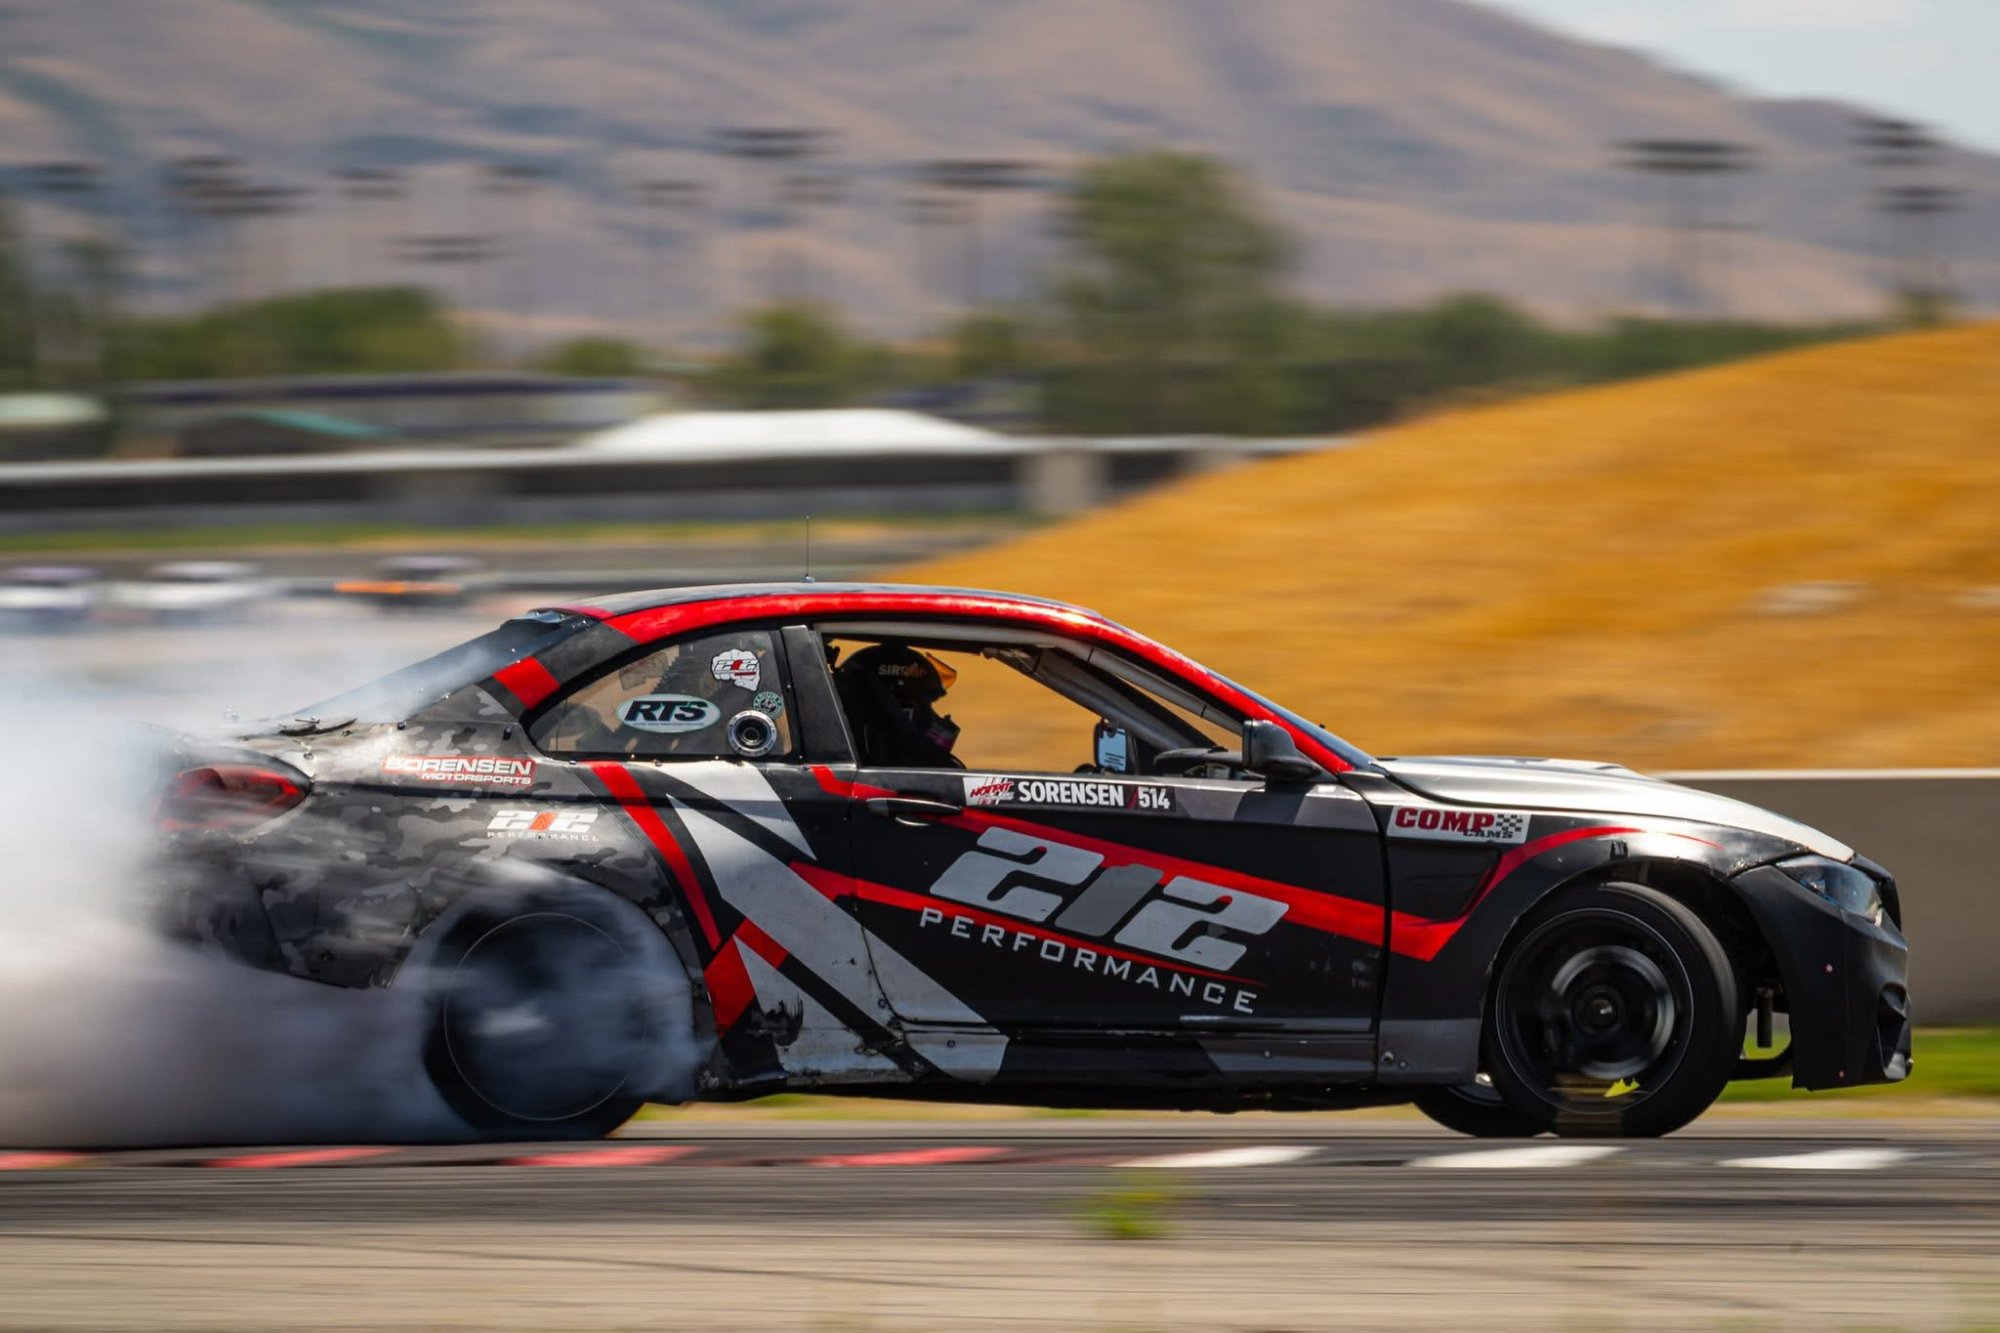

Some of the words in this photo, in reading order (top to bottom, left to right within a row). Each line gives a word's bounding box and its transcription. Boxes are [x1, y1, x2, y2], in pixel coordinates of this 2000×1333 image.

[624, 700, 708, 722] RTS
[384, 757, 532, 776] SORENSEN
[421, 772, 532, 786] MOTORSPORTS
[1018, 780, 1124, 807] SORENSEN
[1138, 786, 1171, 809] 514
[486, 809, 599, 833] 212
[1394, 807, 1495, 833] COMP
[1462, 829, 1514, 839] CAMS
[929, 826, 1290, 971] 212
[919, 906, 1258, 1014] PERFORMANCE
